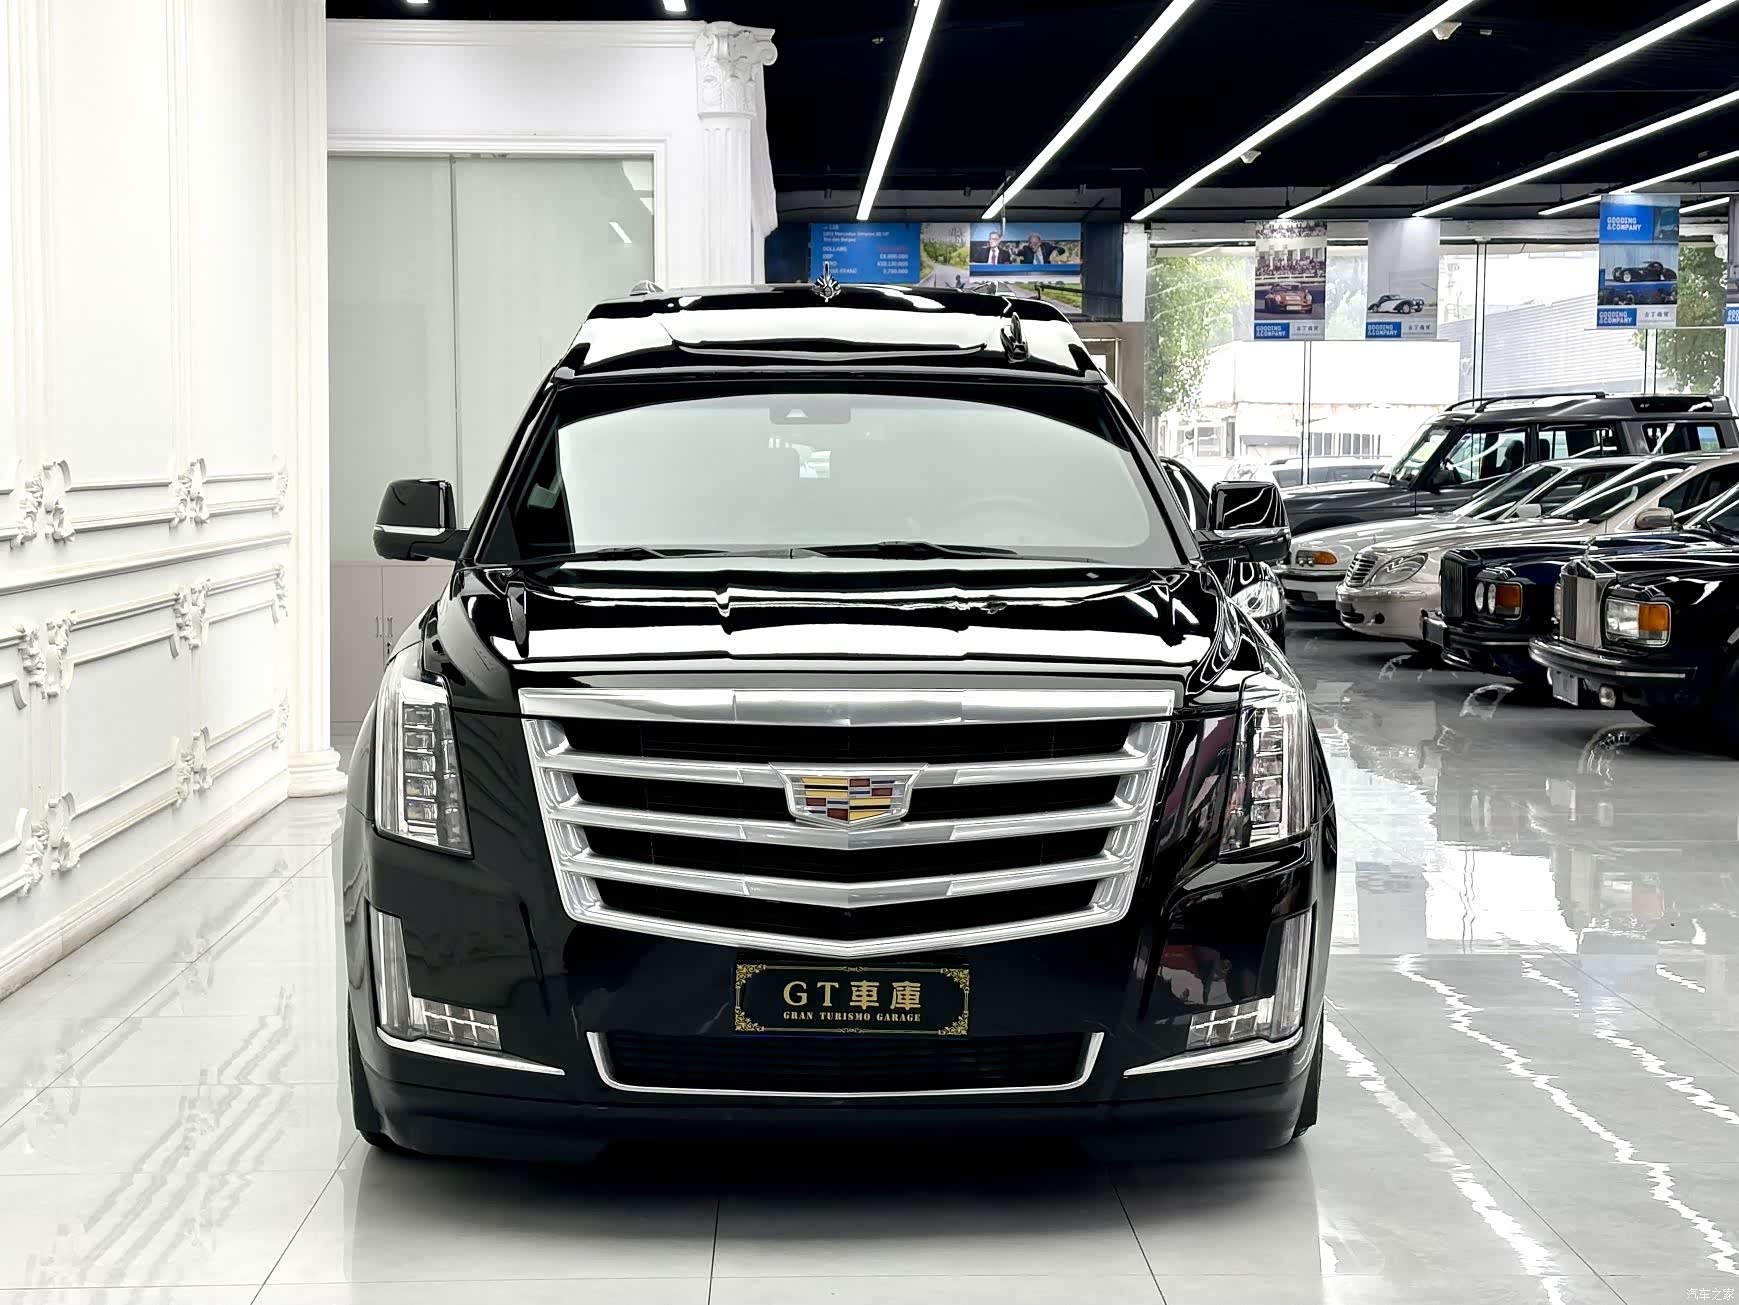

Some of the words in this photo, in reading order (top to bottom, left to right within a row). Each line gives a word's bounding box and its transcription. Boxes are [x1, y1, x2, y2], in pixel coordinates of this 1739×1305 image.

[783, 1011, 813, 1020] GRAN
[820, 1012, 871, 1021] TURISMO
[876, 1012, 921, 1022] GARAGE
